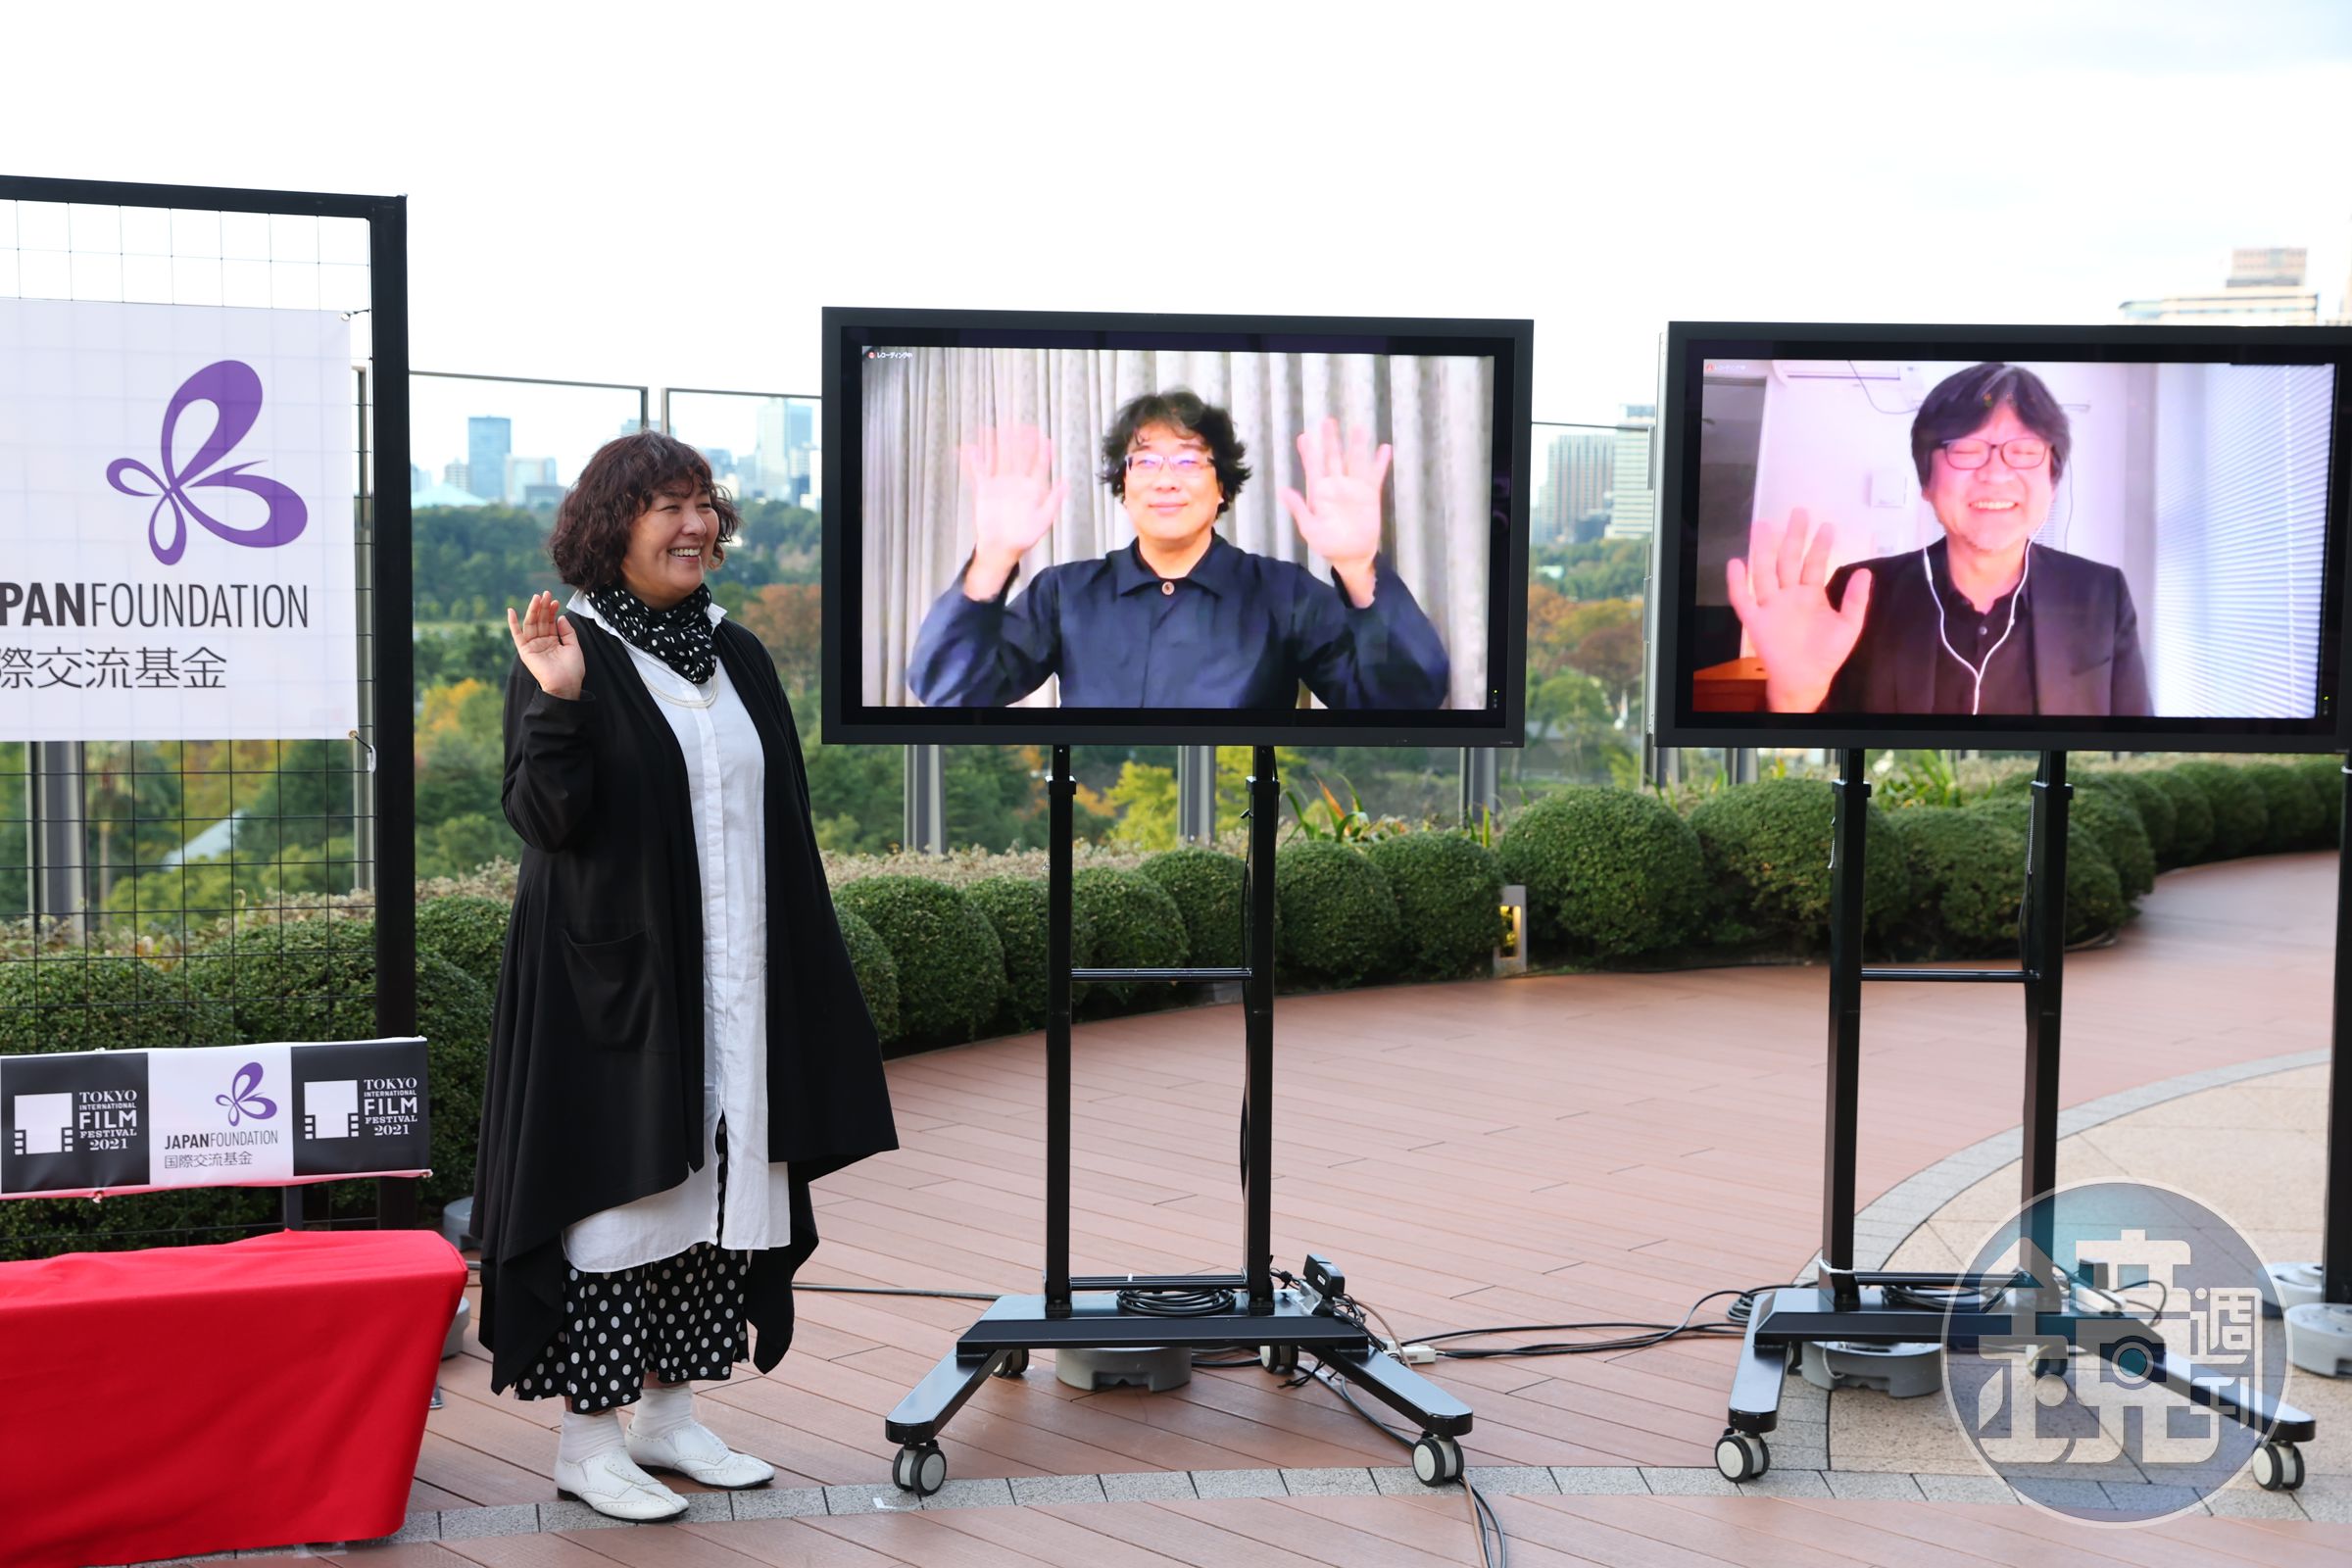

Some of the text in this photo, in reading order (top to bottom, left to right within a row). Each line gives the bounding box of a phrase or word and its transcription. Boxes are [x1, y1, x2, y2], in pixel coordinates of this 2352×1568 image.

[364, 1077, 417, 1090] TOKYO
[79, 1090, 137, 1103] TOKYO
[364, 1097, 417, 1115] FILM
[79, 1110, 137, 1129] FILM
[365, 1114, 417, 1124] FESTIVAL
[80, 1129, 137, 1139] FESTIVAL
[373, 1124, 410, 1136] 2021
[89, 1139, 128, 1151] 2021
[165, 1151, 253, 1168] 国際交流基金
